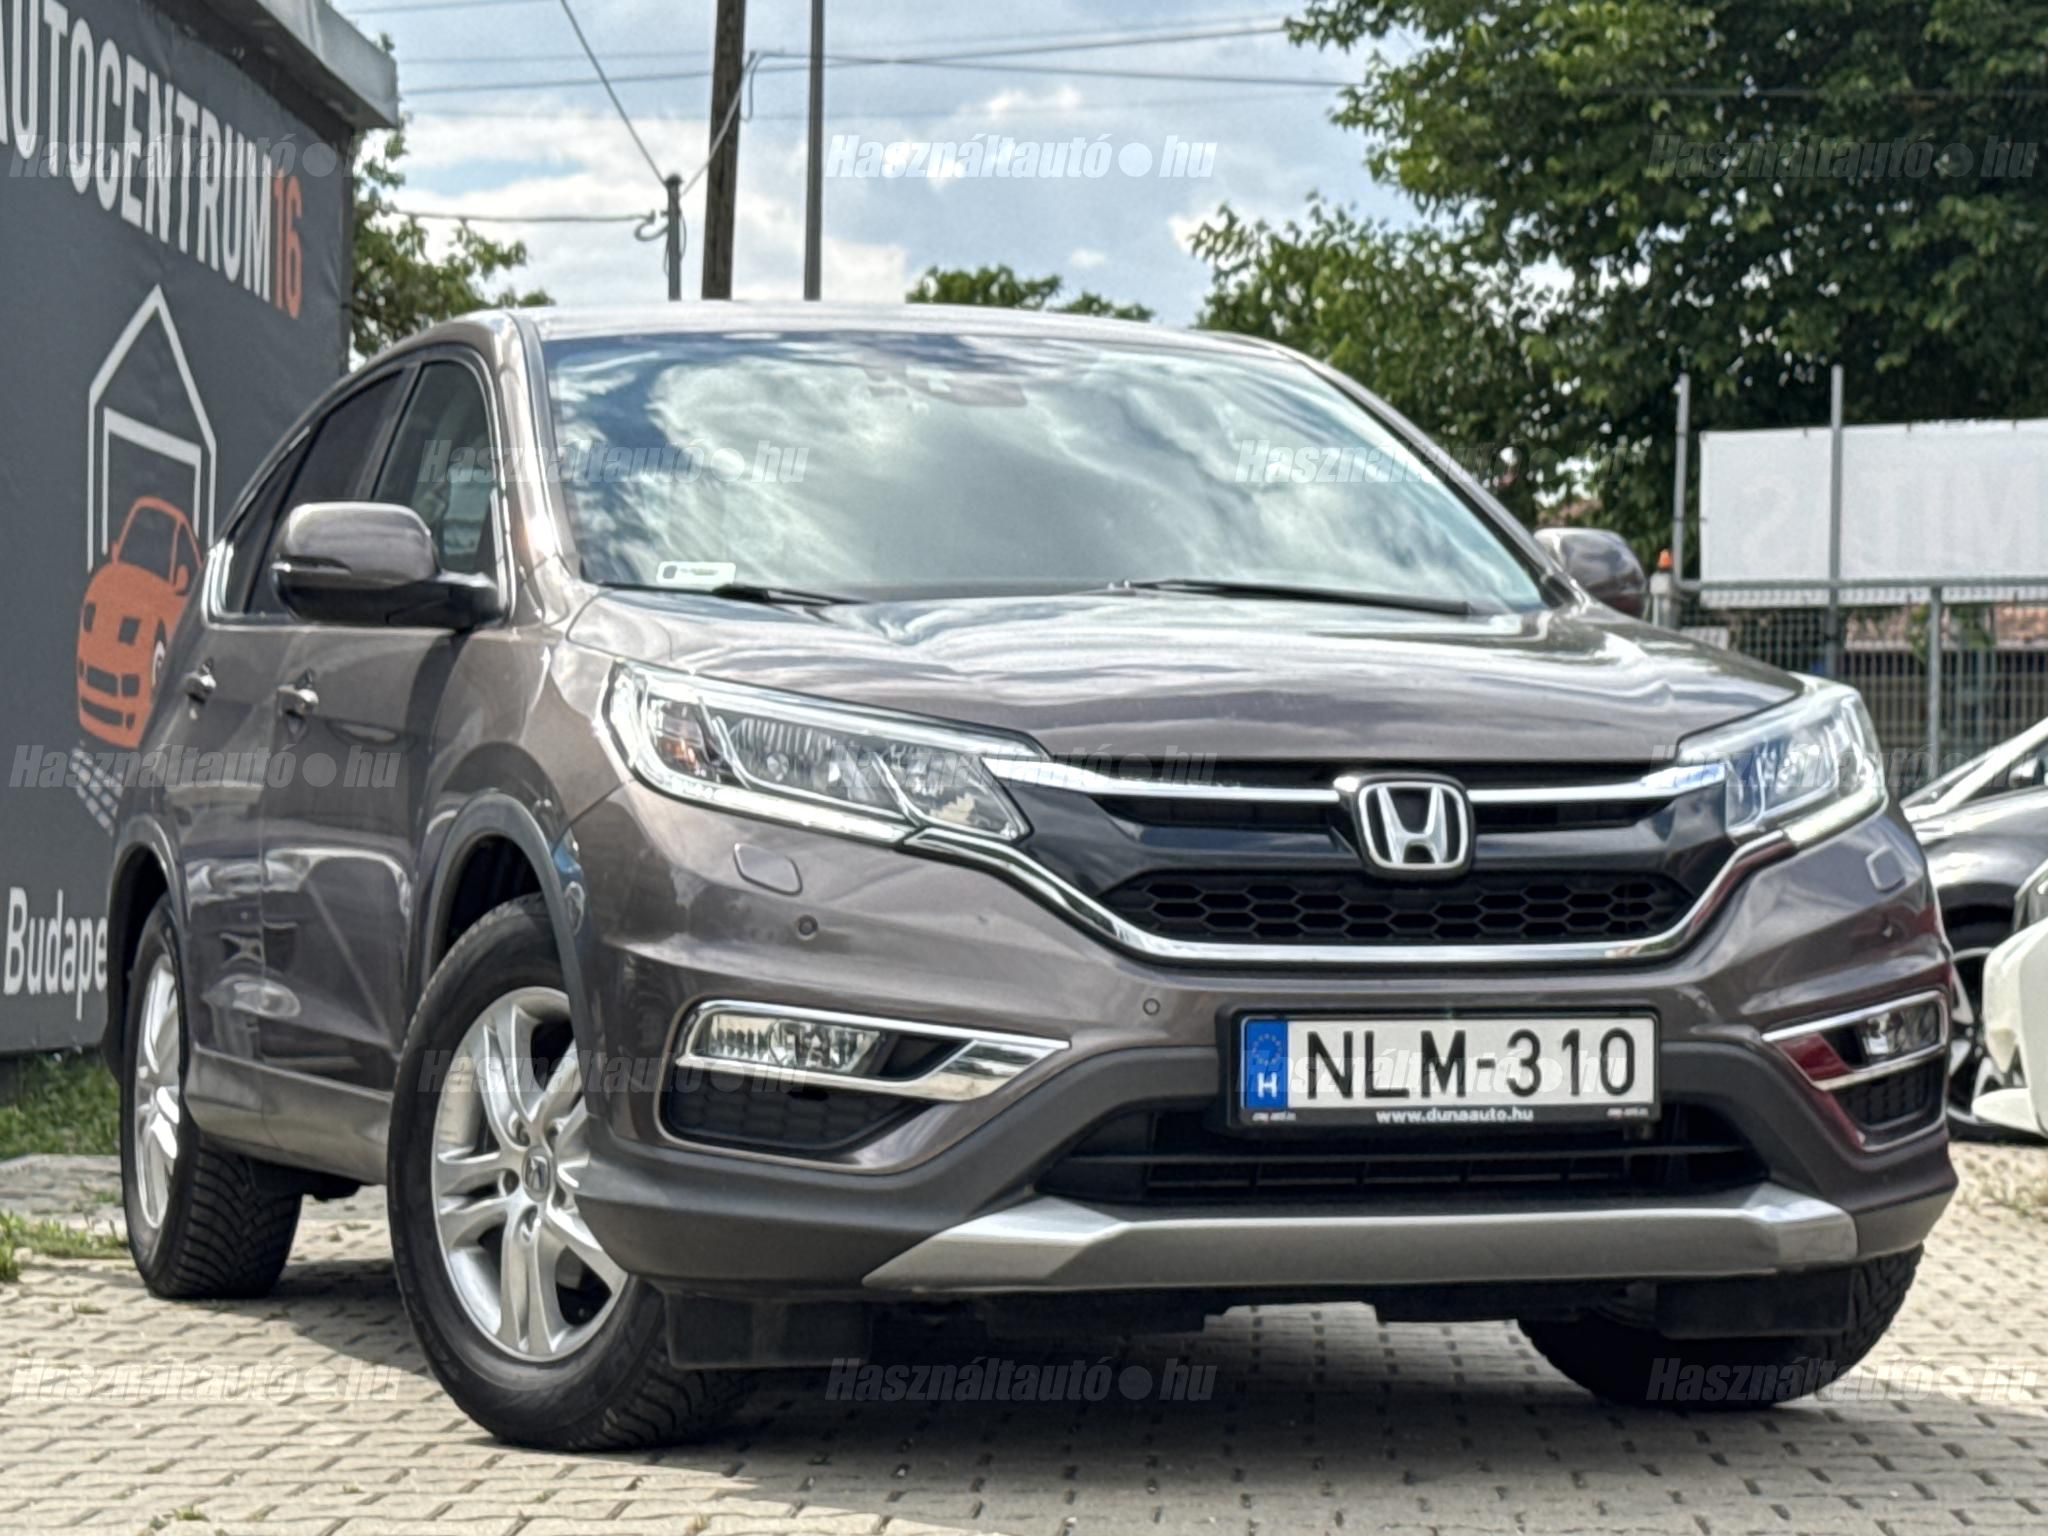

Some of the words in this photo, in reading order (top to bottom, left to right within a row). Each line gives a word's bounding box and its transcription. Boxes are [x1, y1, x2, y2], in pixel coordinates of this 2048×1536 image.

[0, 0, 302, 320] UTOCENTRUM16
[1306, 1028, 1636, 1099] NLM-310
[1376, 1107, 1535, 1124] www.dunaauto.hu
